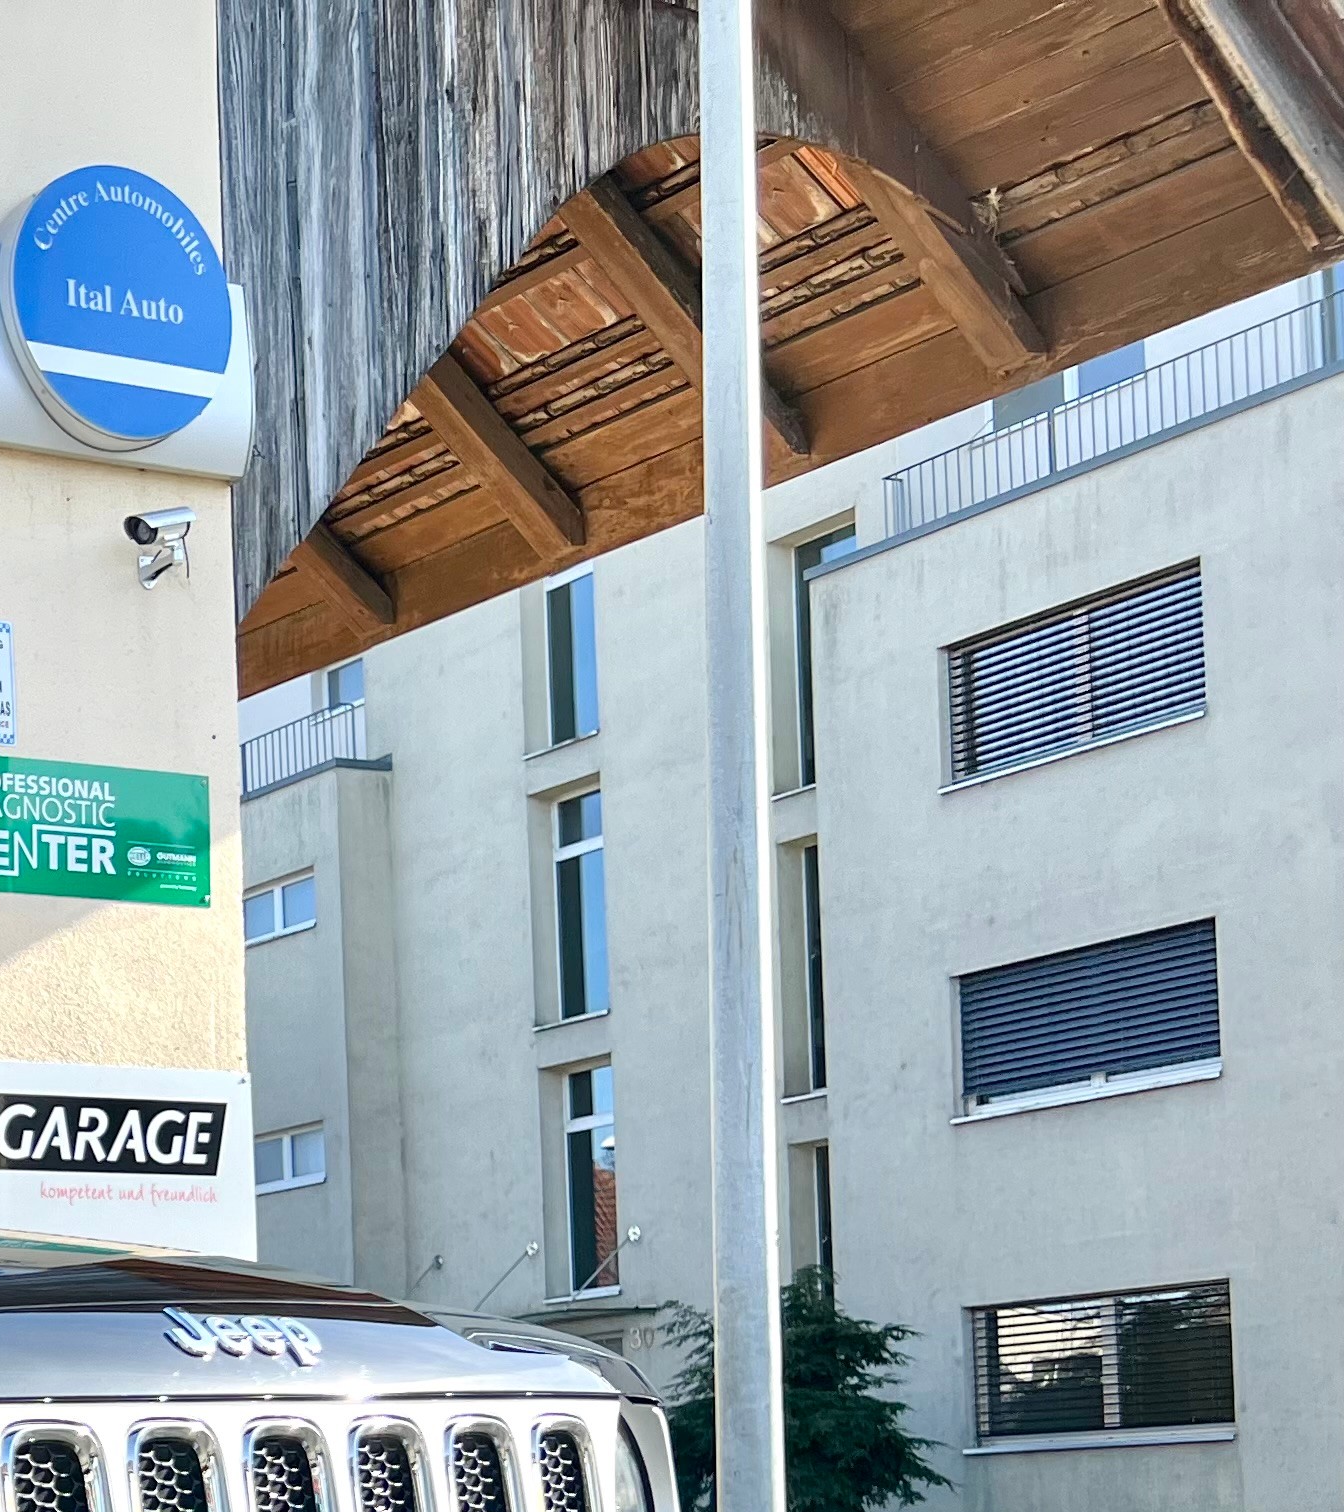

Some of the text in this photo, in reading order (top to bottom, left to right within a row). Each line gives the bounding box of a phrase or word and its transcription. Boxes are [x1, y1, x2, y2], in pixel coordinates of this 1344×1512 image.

[33, 179, 207, 277] Centre Automobiles
[66, 277, 184, 325] Ital Auto
[40, 1181, 218, 1207] kompetent und freundlich
[162, 1306, 323, 1367] Jeep
